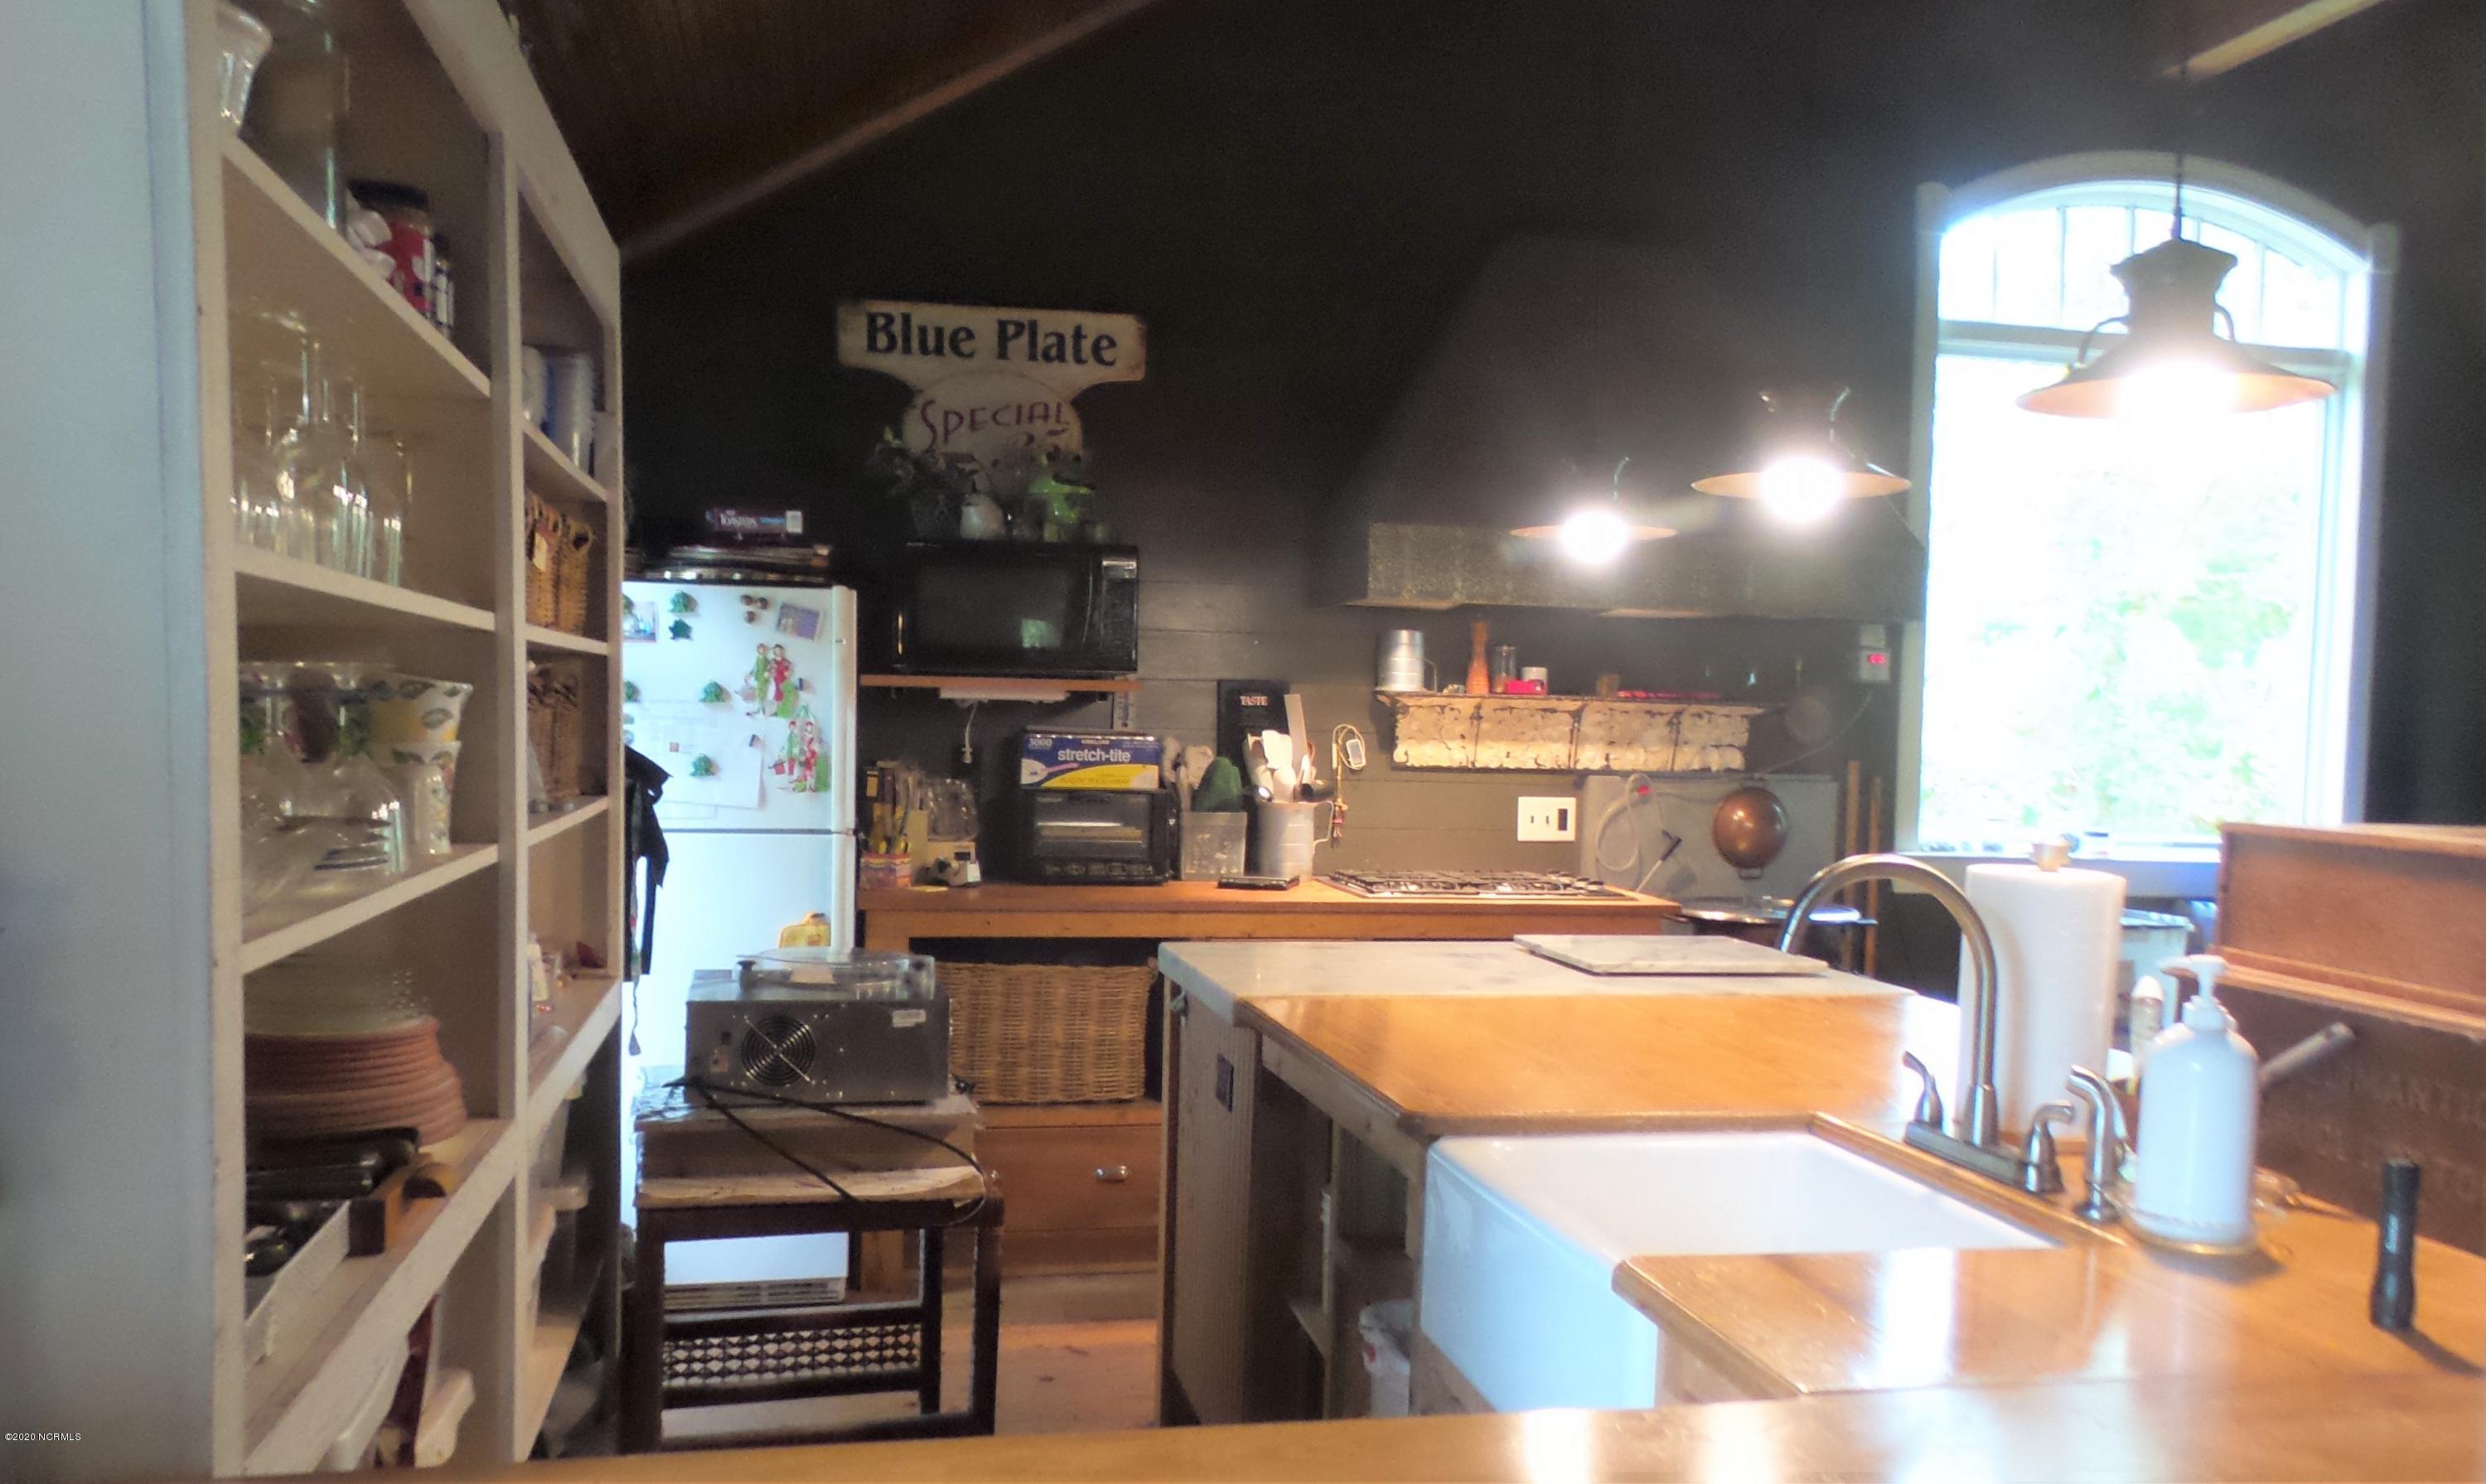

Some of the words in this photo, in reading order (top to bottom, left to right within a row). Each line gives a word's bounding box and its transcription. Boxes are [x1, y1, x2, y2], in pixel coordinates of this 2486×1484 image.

[865, 311, 976, 360] Blue
[996, 317, 1118, 367] Plate
[920, 398, 1071, 453] SPECIAL
[1057, 747, 1132, 763] stretch-tite
